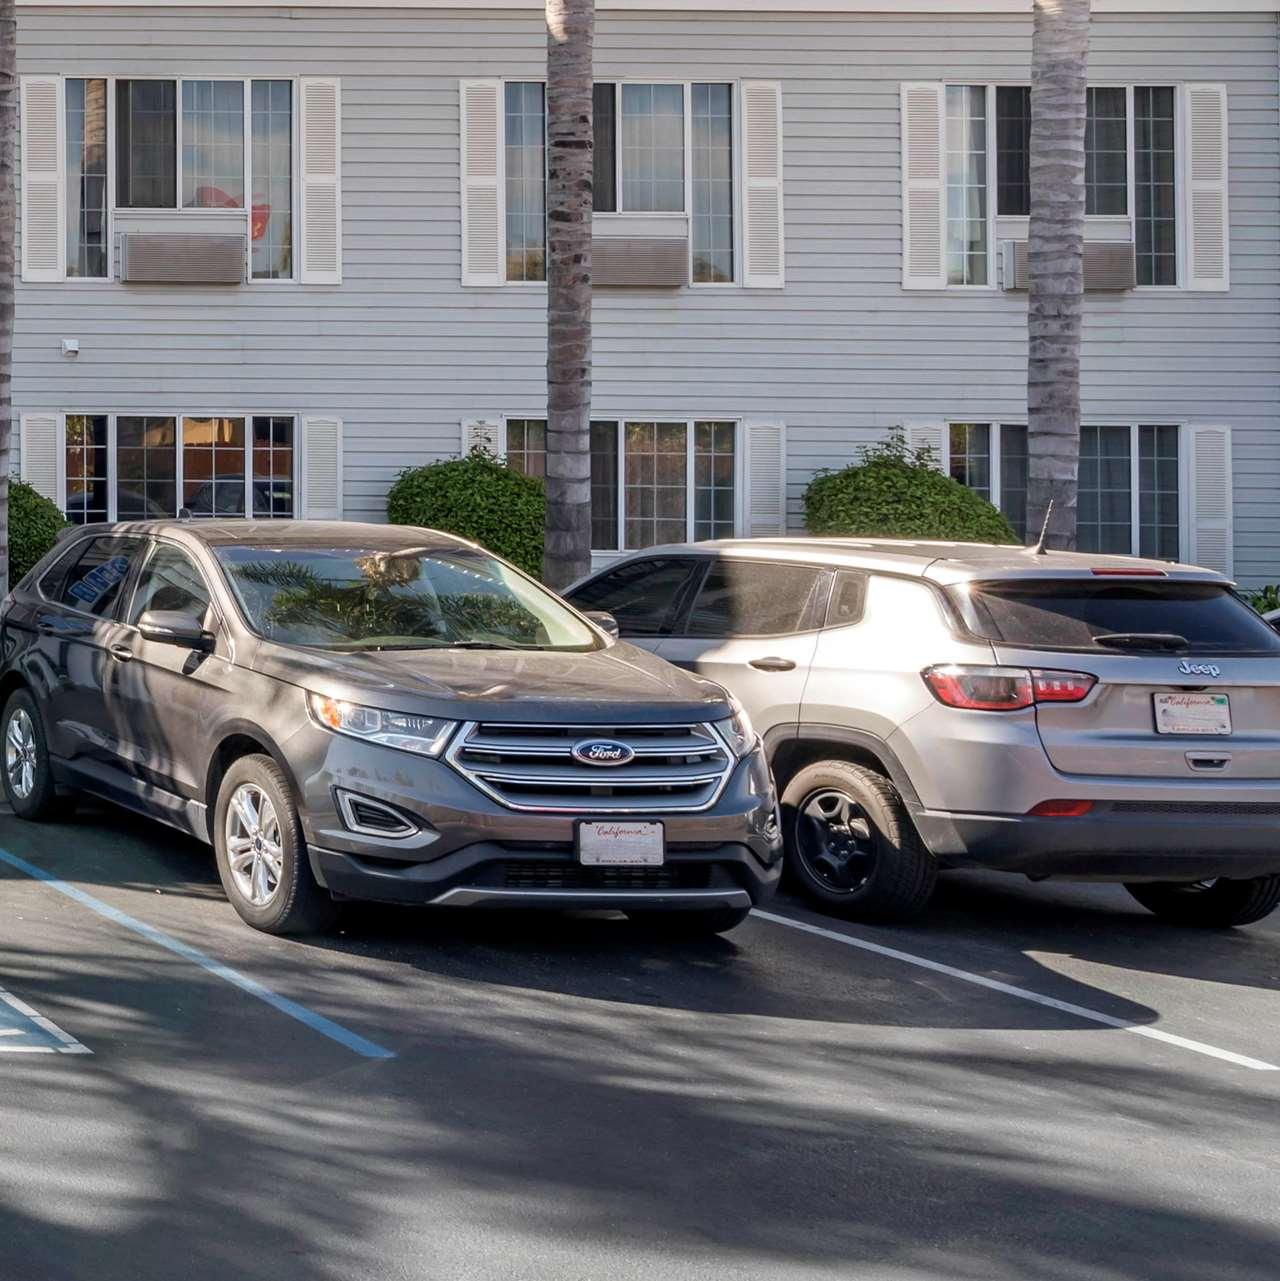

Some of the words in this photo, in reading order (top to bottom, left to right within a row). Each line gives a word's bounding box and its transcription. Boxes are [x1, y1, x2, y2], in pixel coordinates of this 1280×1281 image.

[1178, 661, 1220, 677] Jeep
[589, 744, 622, 759] Ford
[597, 826, 647, 838] California
